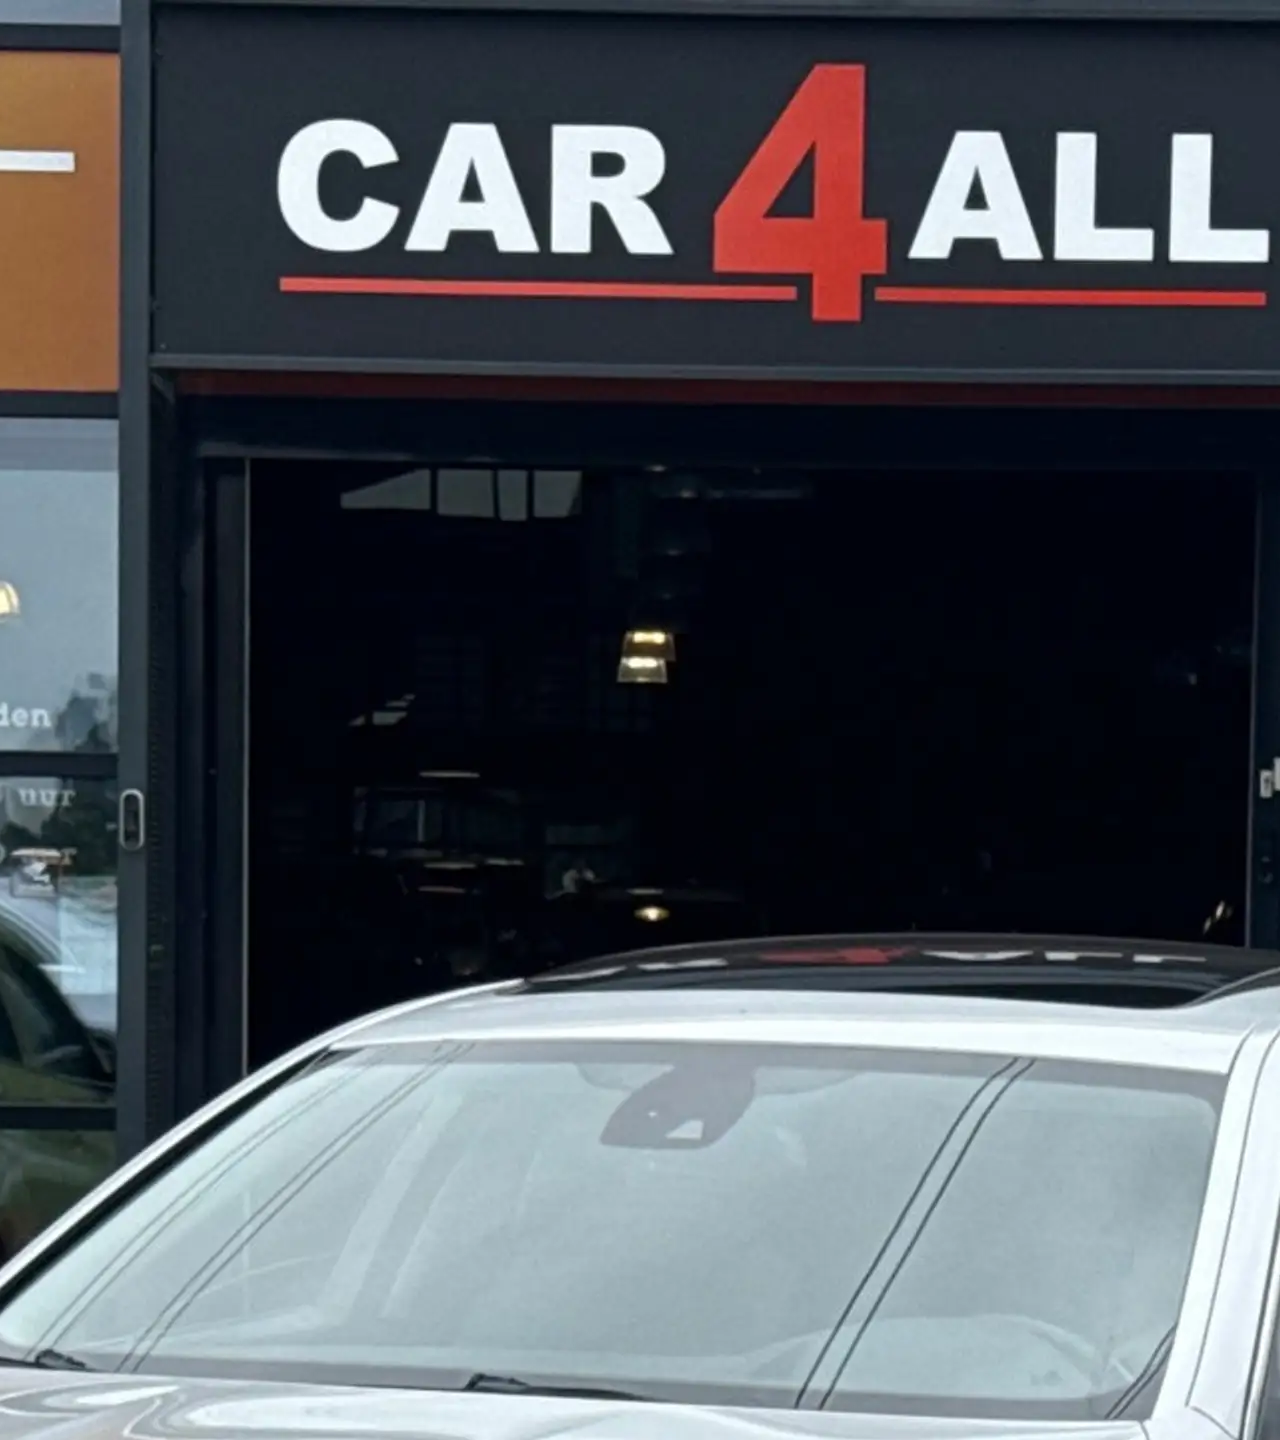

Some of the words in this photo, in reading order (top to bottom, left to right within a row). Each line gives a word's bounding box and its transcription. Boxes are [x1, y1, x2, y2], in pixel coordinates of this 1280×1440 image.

[277, 118, 674, 255] CAR
[713, 63, 888, 322] 4
[907, 130, 1270, 264] ALL
